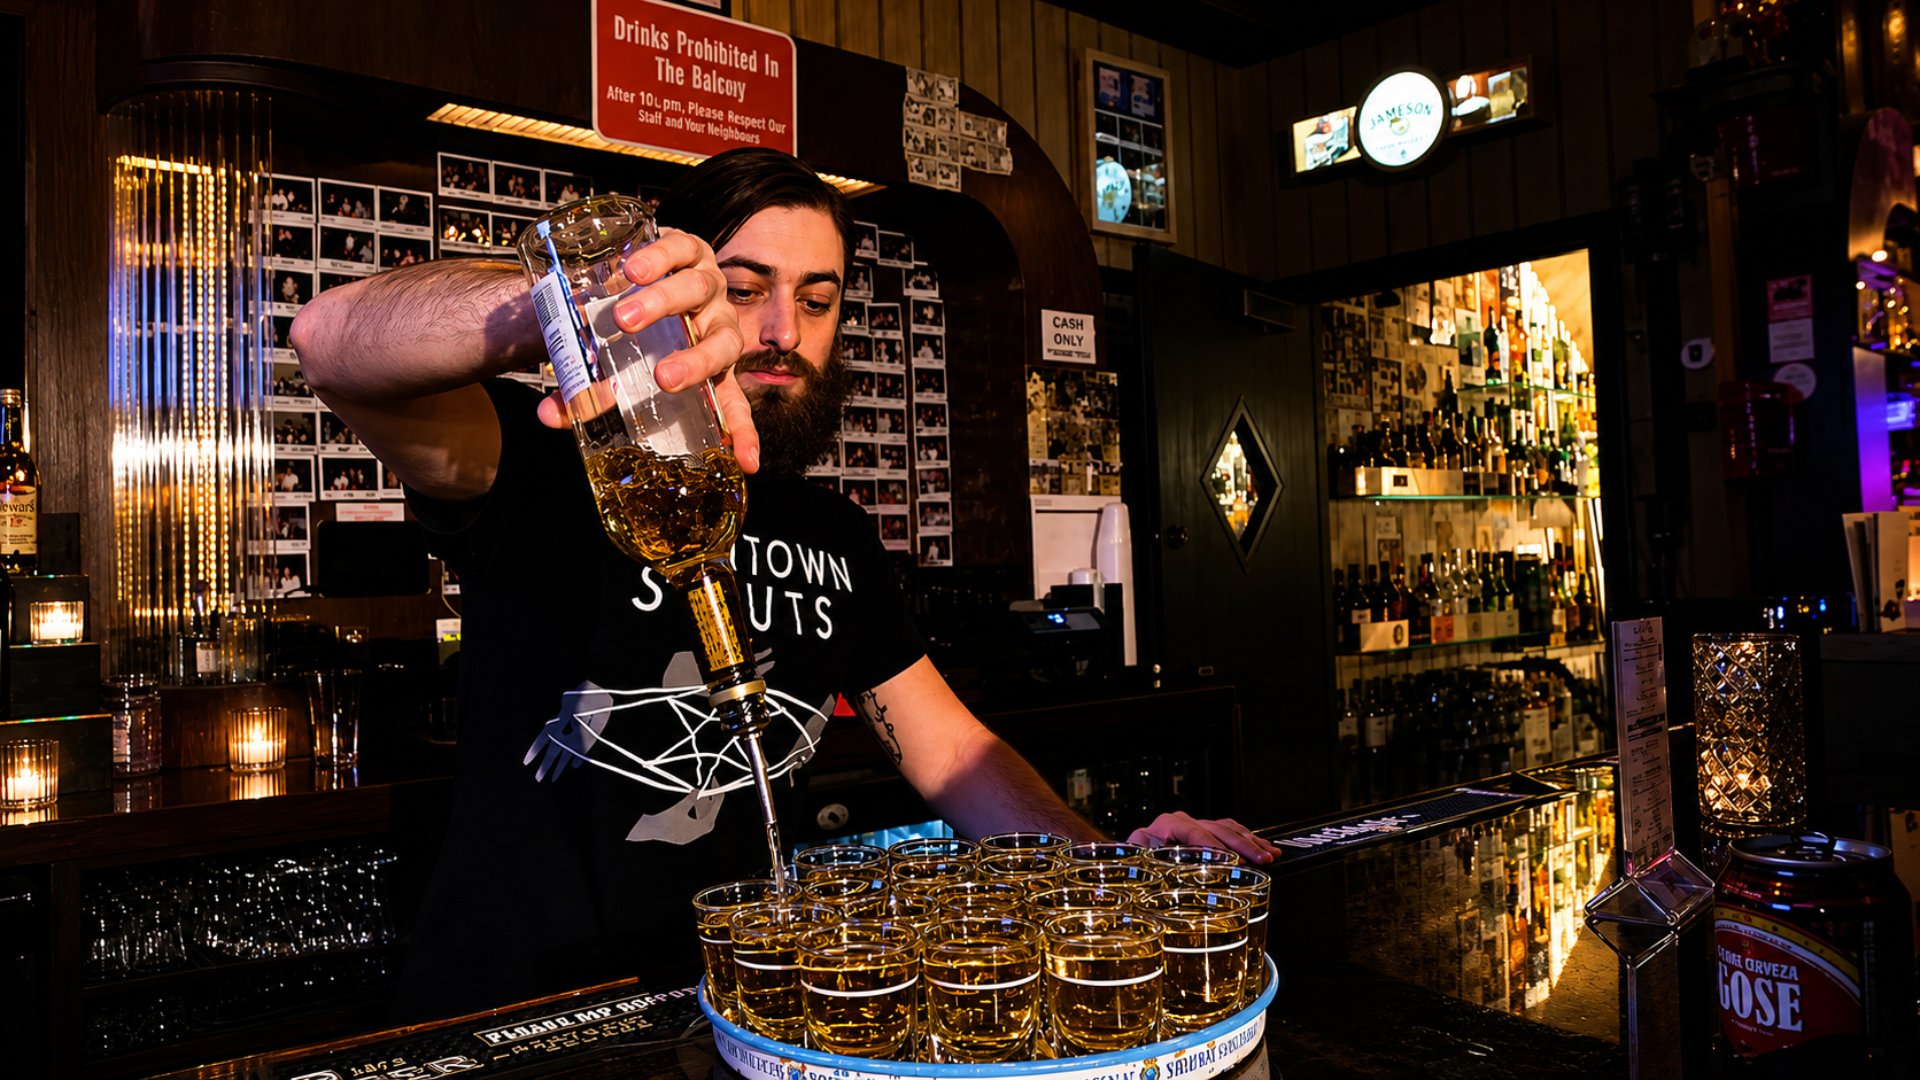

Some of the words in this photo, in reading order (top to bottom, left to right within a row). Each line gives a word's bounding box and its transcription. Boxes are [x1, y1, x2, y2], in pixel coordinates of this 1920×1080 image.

[614, 15, 669, 51] Drinks
[676, 30, 758, 73] Prohibited
[765, 53, 780, 78] In
[655, 56, 685, 86] The
[606, 85, 636, 104] After
[688, 101, 724, 121] Please
[728, 110, 766, 131] Respect
[768, 119, 787, 134] Our
[1370, 102, 1434, 130] JAMESON
[638, 109, 662, 125] Staff
[665, 115, 683, 129] and
[685, 118, 705, 134] Your
[707, 123, 761, 145] Neighbours
[1052, 316, 1084, 330] CASH
[1053, 333, 1084, 347] ONLY
[1718, 961, 1803, 1032] GOSE
